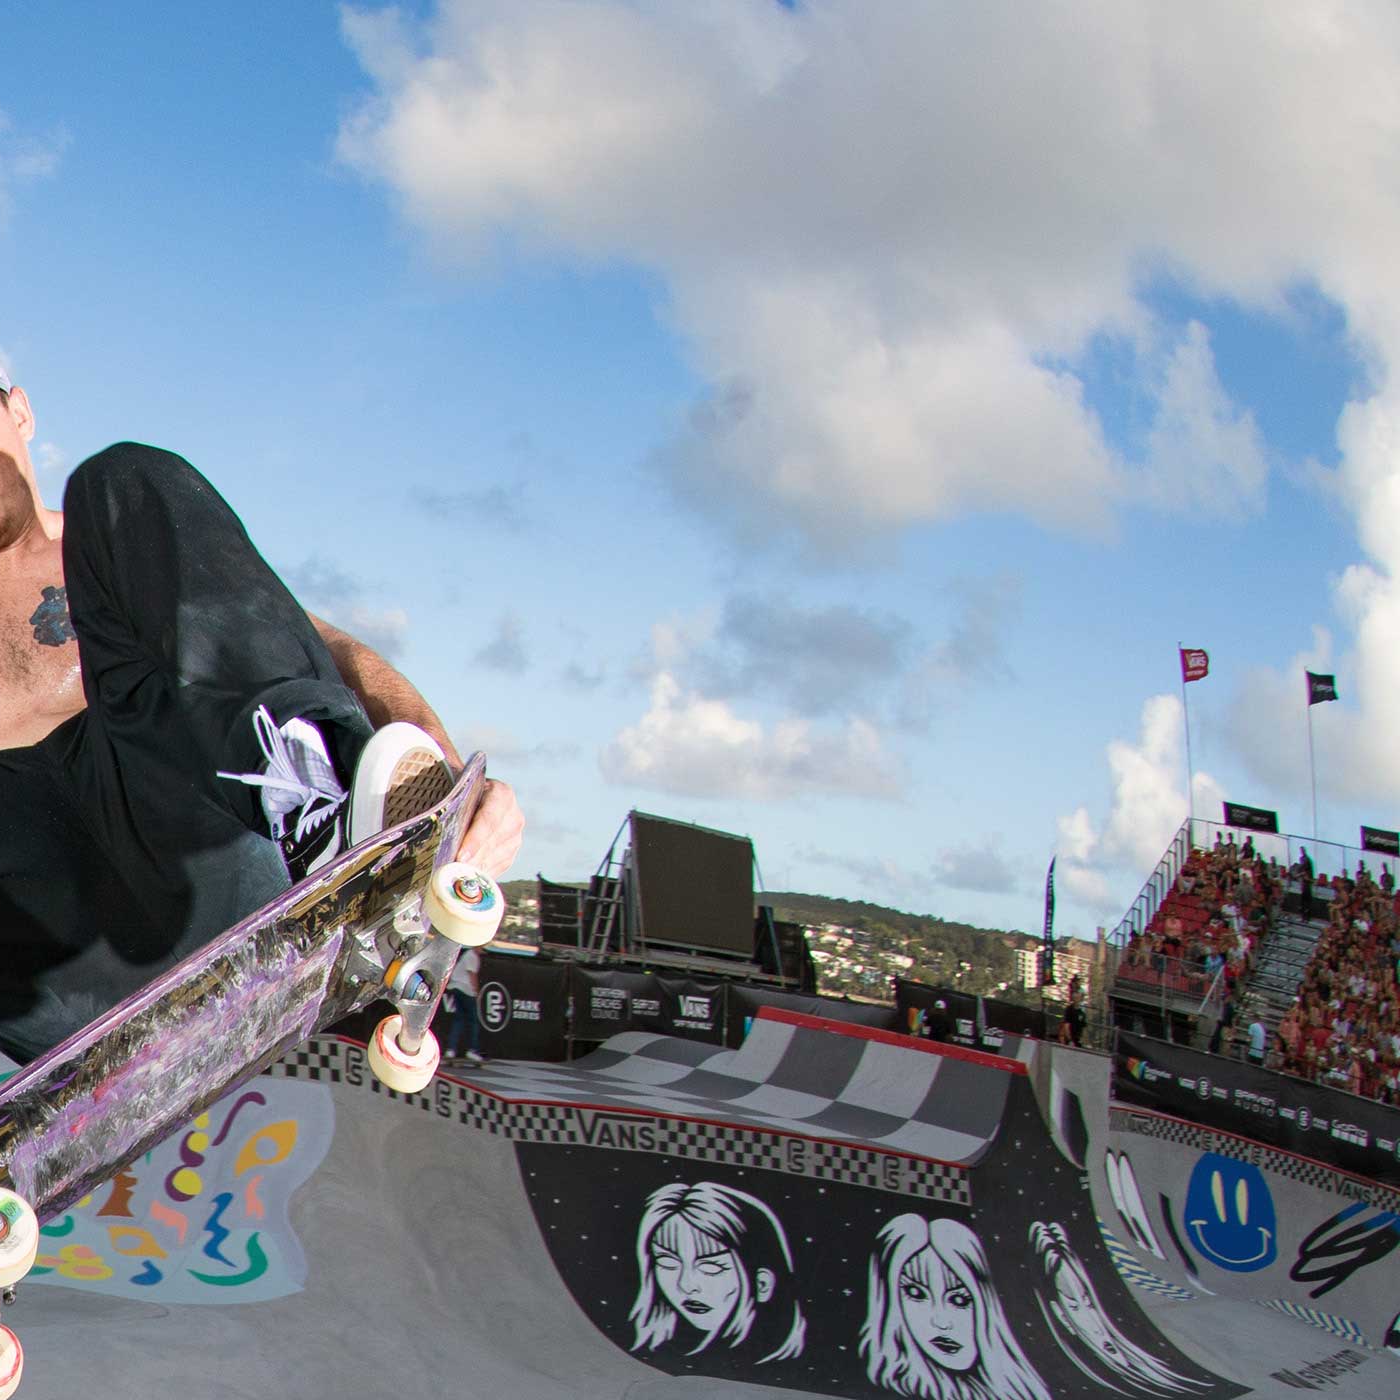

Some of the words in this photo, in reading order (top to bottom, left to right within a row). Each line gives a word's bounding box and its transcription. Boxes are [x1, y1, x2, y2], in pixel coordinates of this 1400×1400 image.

[512, 999, 541, 1012] PARK
[678, 994, 711, 1019] VANS
[574, 1110, 658, 1151] VANS
[1333, 1173, 1374, 1202] VANS
